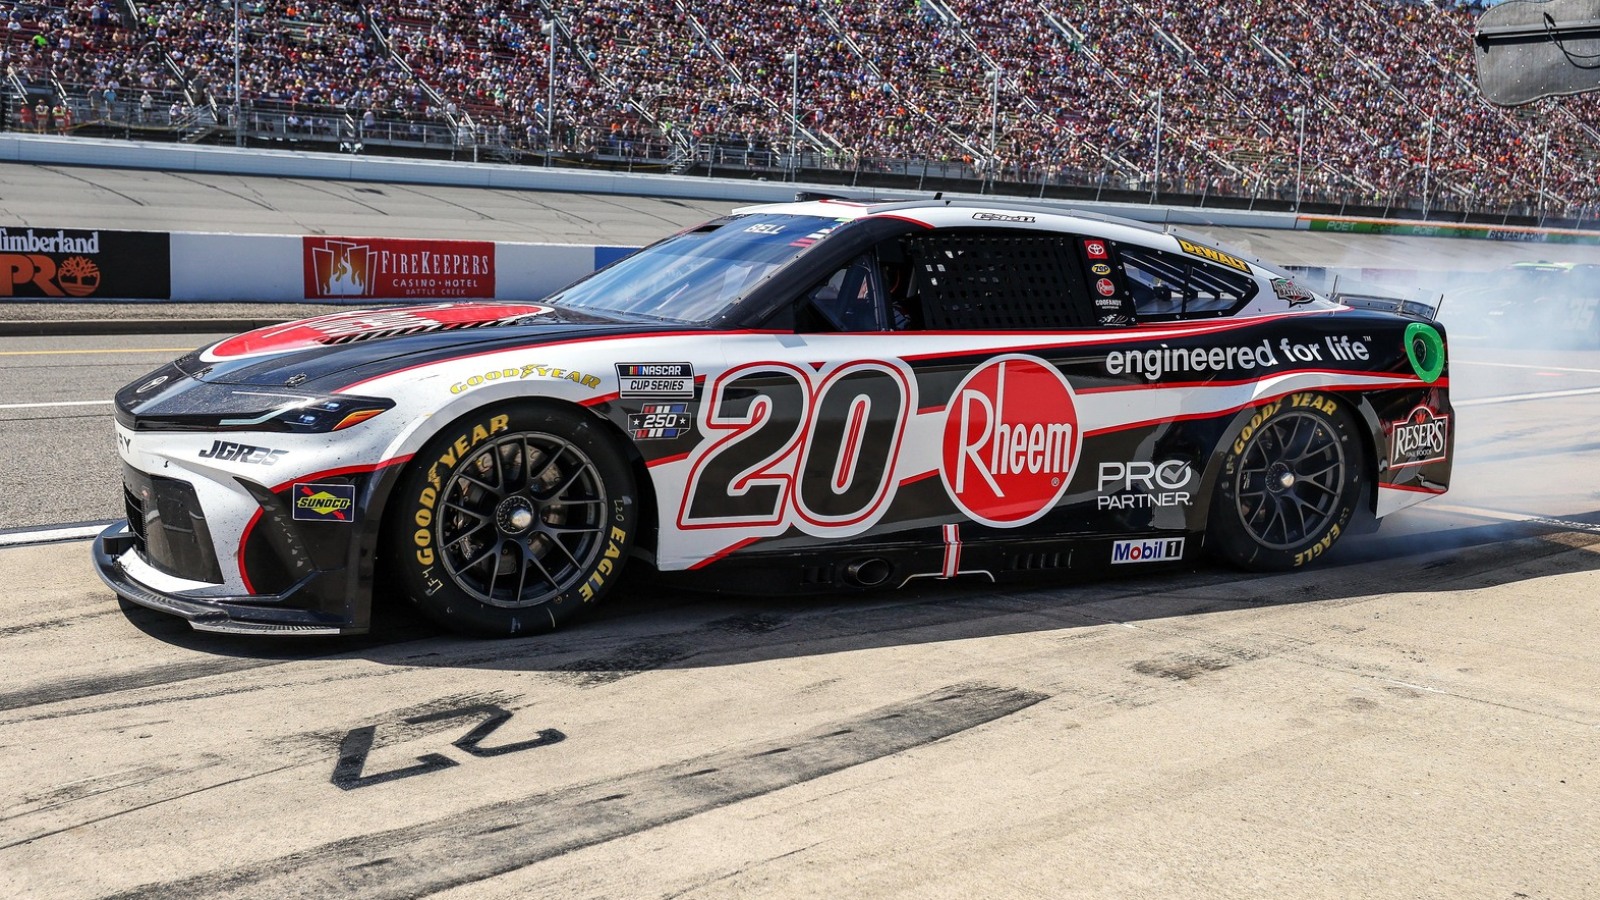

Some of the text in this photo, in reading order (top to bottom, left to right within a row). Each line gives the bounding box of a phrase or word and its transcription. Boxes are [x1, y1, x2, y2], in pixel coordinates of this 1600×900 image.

[744, 223, 786, 235] BELL
[392, 279, 478, 288] CASINO HOTEL
[1106, 339, 1279, 380] engineered
[1280, 337, 1323, 362] for
[642, 365, 682, 376] NASCAR
[630, 380, 685, 391] CUP SERIES
[643, 414, 677, 428] 250
[955, 361, 1072, 498] Rheem
[676, 360, 909, 529] 20
[1394, 420, 1443, 463] RESER'S
[299, 497, 350, 509] SUNOCO
[1114, 541, 1177, 561] Mobil 1
[1293, 523, 1341, 567] EAGLE
[578, 525, 627, 602] EAGLE
